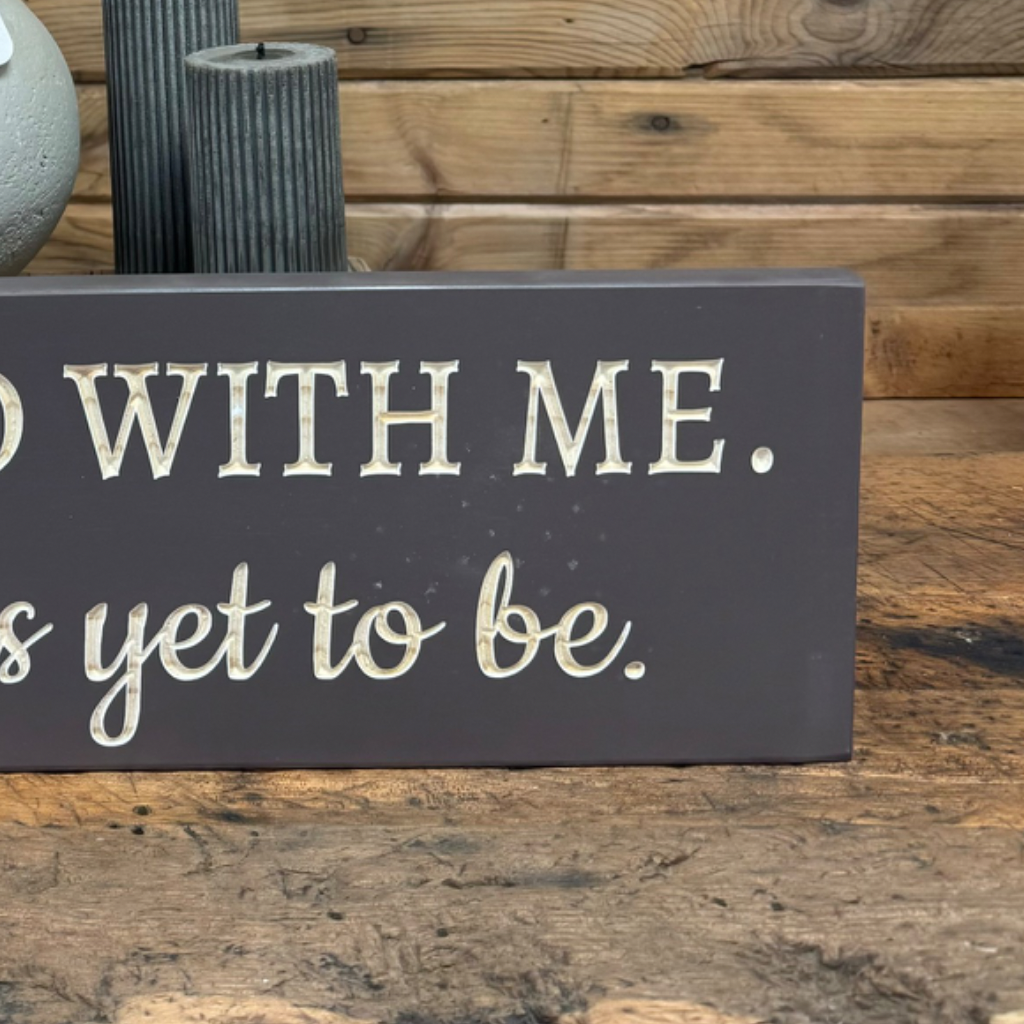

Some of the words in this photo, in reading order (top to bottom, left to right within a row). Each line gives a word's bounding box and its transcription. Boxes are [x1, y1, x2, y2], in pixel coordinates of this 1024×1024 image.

[63, 359, 463, 481] WITH
[512, 357, 776, 478] ME.
[84, 562, 280, 748] yet
[303, 561, 447, 680] to
[475, 551, 647, 680] be.
